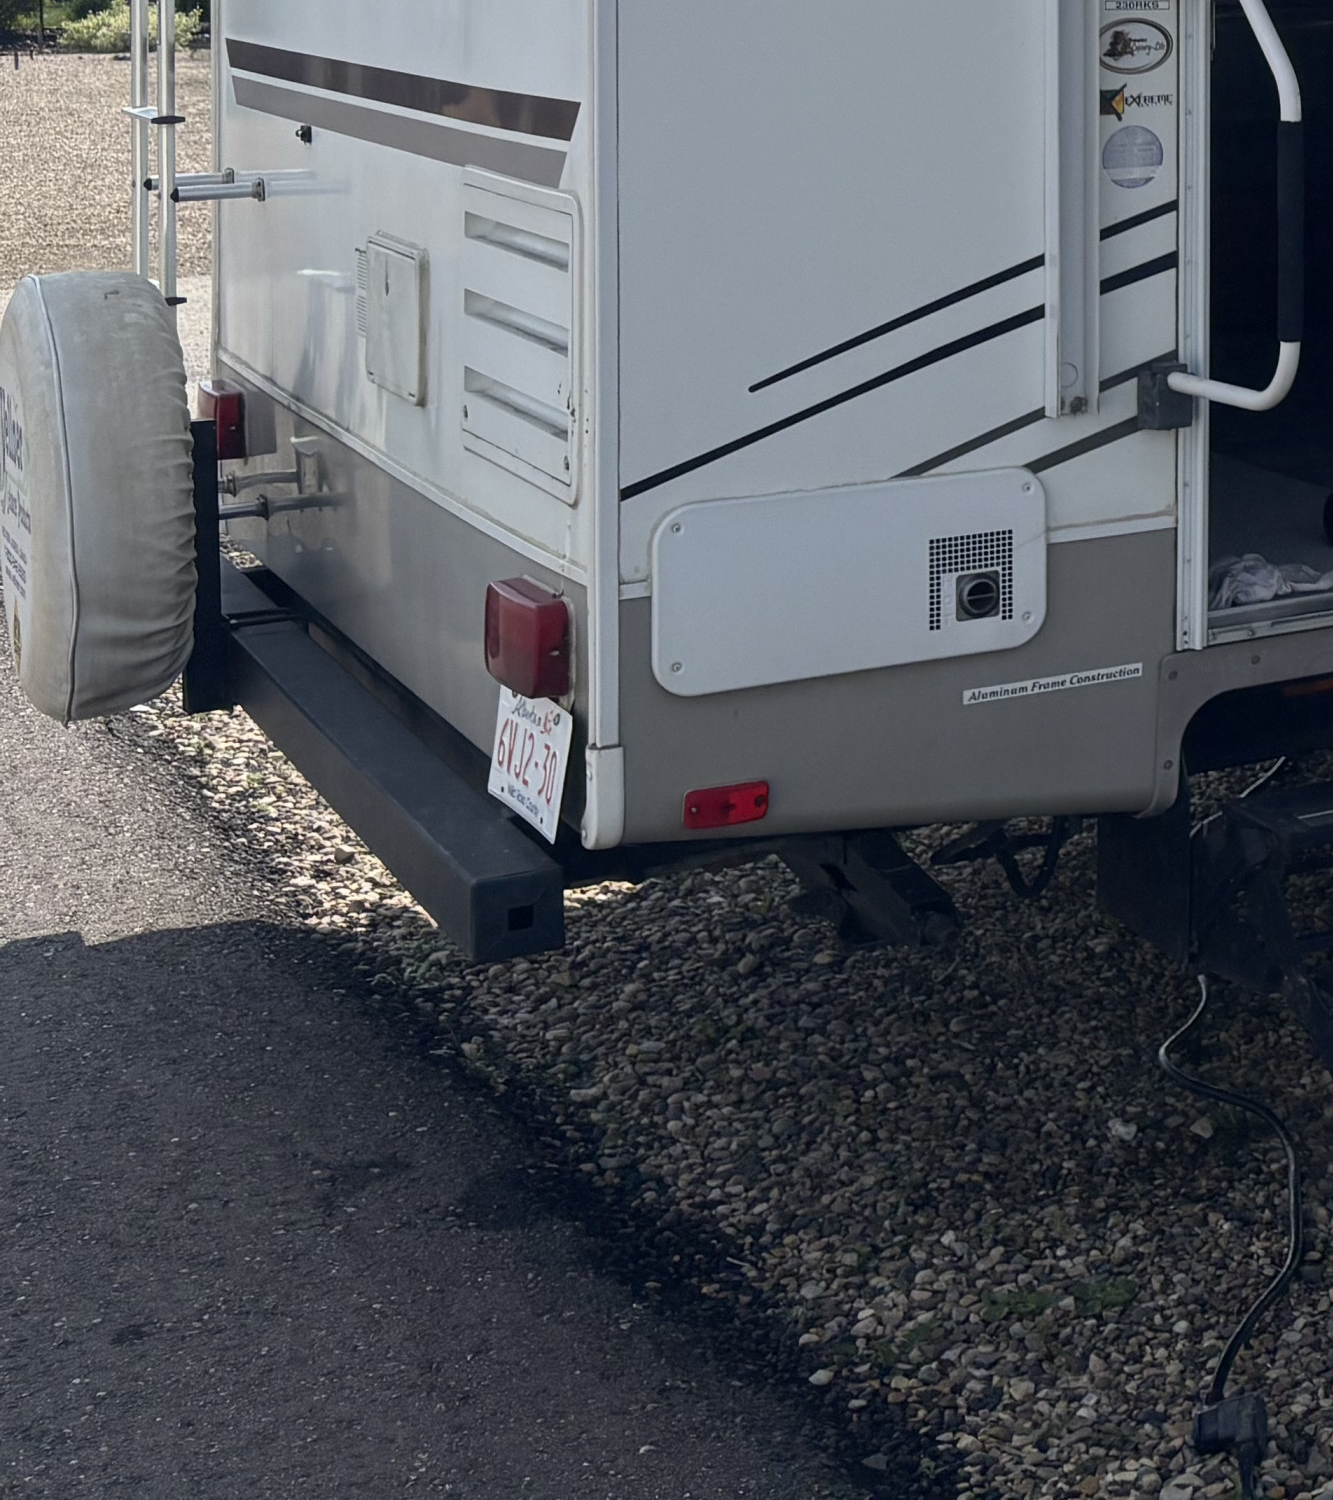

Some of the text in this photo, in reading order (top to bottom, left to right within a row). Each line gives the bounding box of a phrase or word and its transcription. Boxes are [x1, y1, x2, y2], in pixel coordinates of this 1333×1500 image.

[968, 666, 1141, 703] Aluminum Frame Construction
